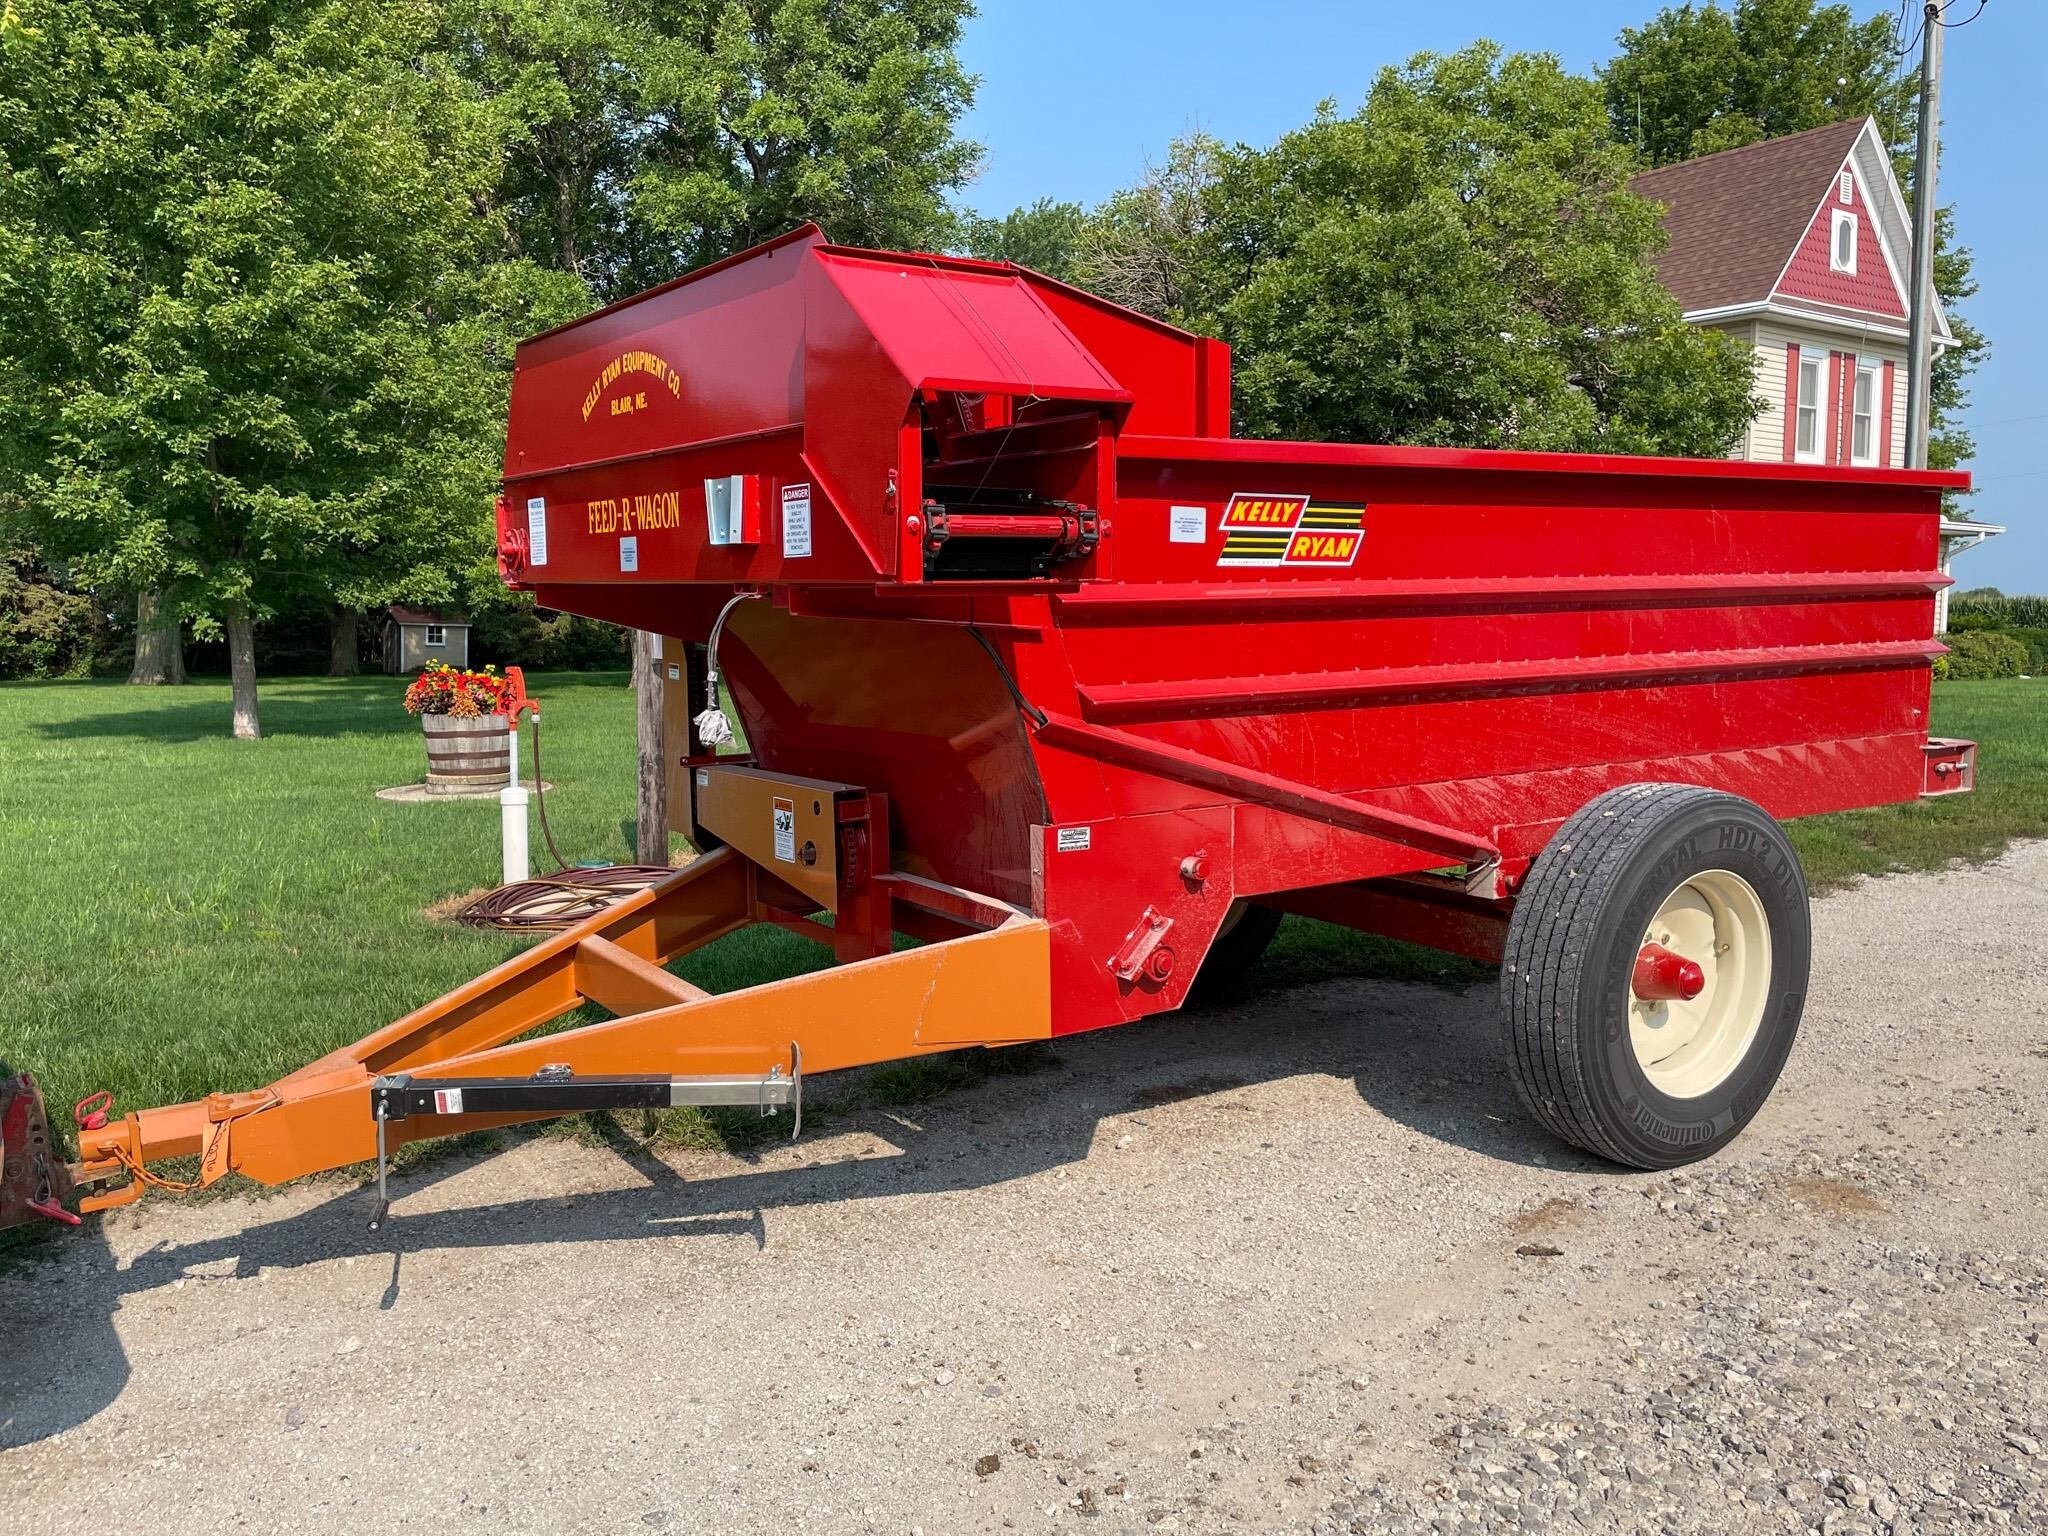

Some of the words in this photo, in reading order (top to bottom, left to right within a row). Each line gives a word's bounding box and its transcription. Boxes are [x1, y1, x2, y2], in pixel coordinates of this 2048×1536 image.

[582, 378, 601, 422] KELLY
[602, 357, 621, 389] RYAN
[623, 350, 668, 381] EQUIPMENT
[667, 369, 680, 399] CO.
[611, 396, 633, 416] BLAIR,
[636, 392, 648, 410] NE.
[787, 488, 809, 500] DANGER
[588, 491, 680, 534] FEED-R-WAGON
[1230, 501, 1299, 523] KELLY
[1292, 536, 1355, 557] RYAN
[1718, 825, 1772, 863] HDL2
[1633, 1104, 1716, 1147] Continental
